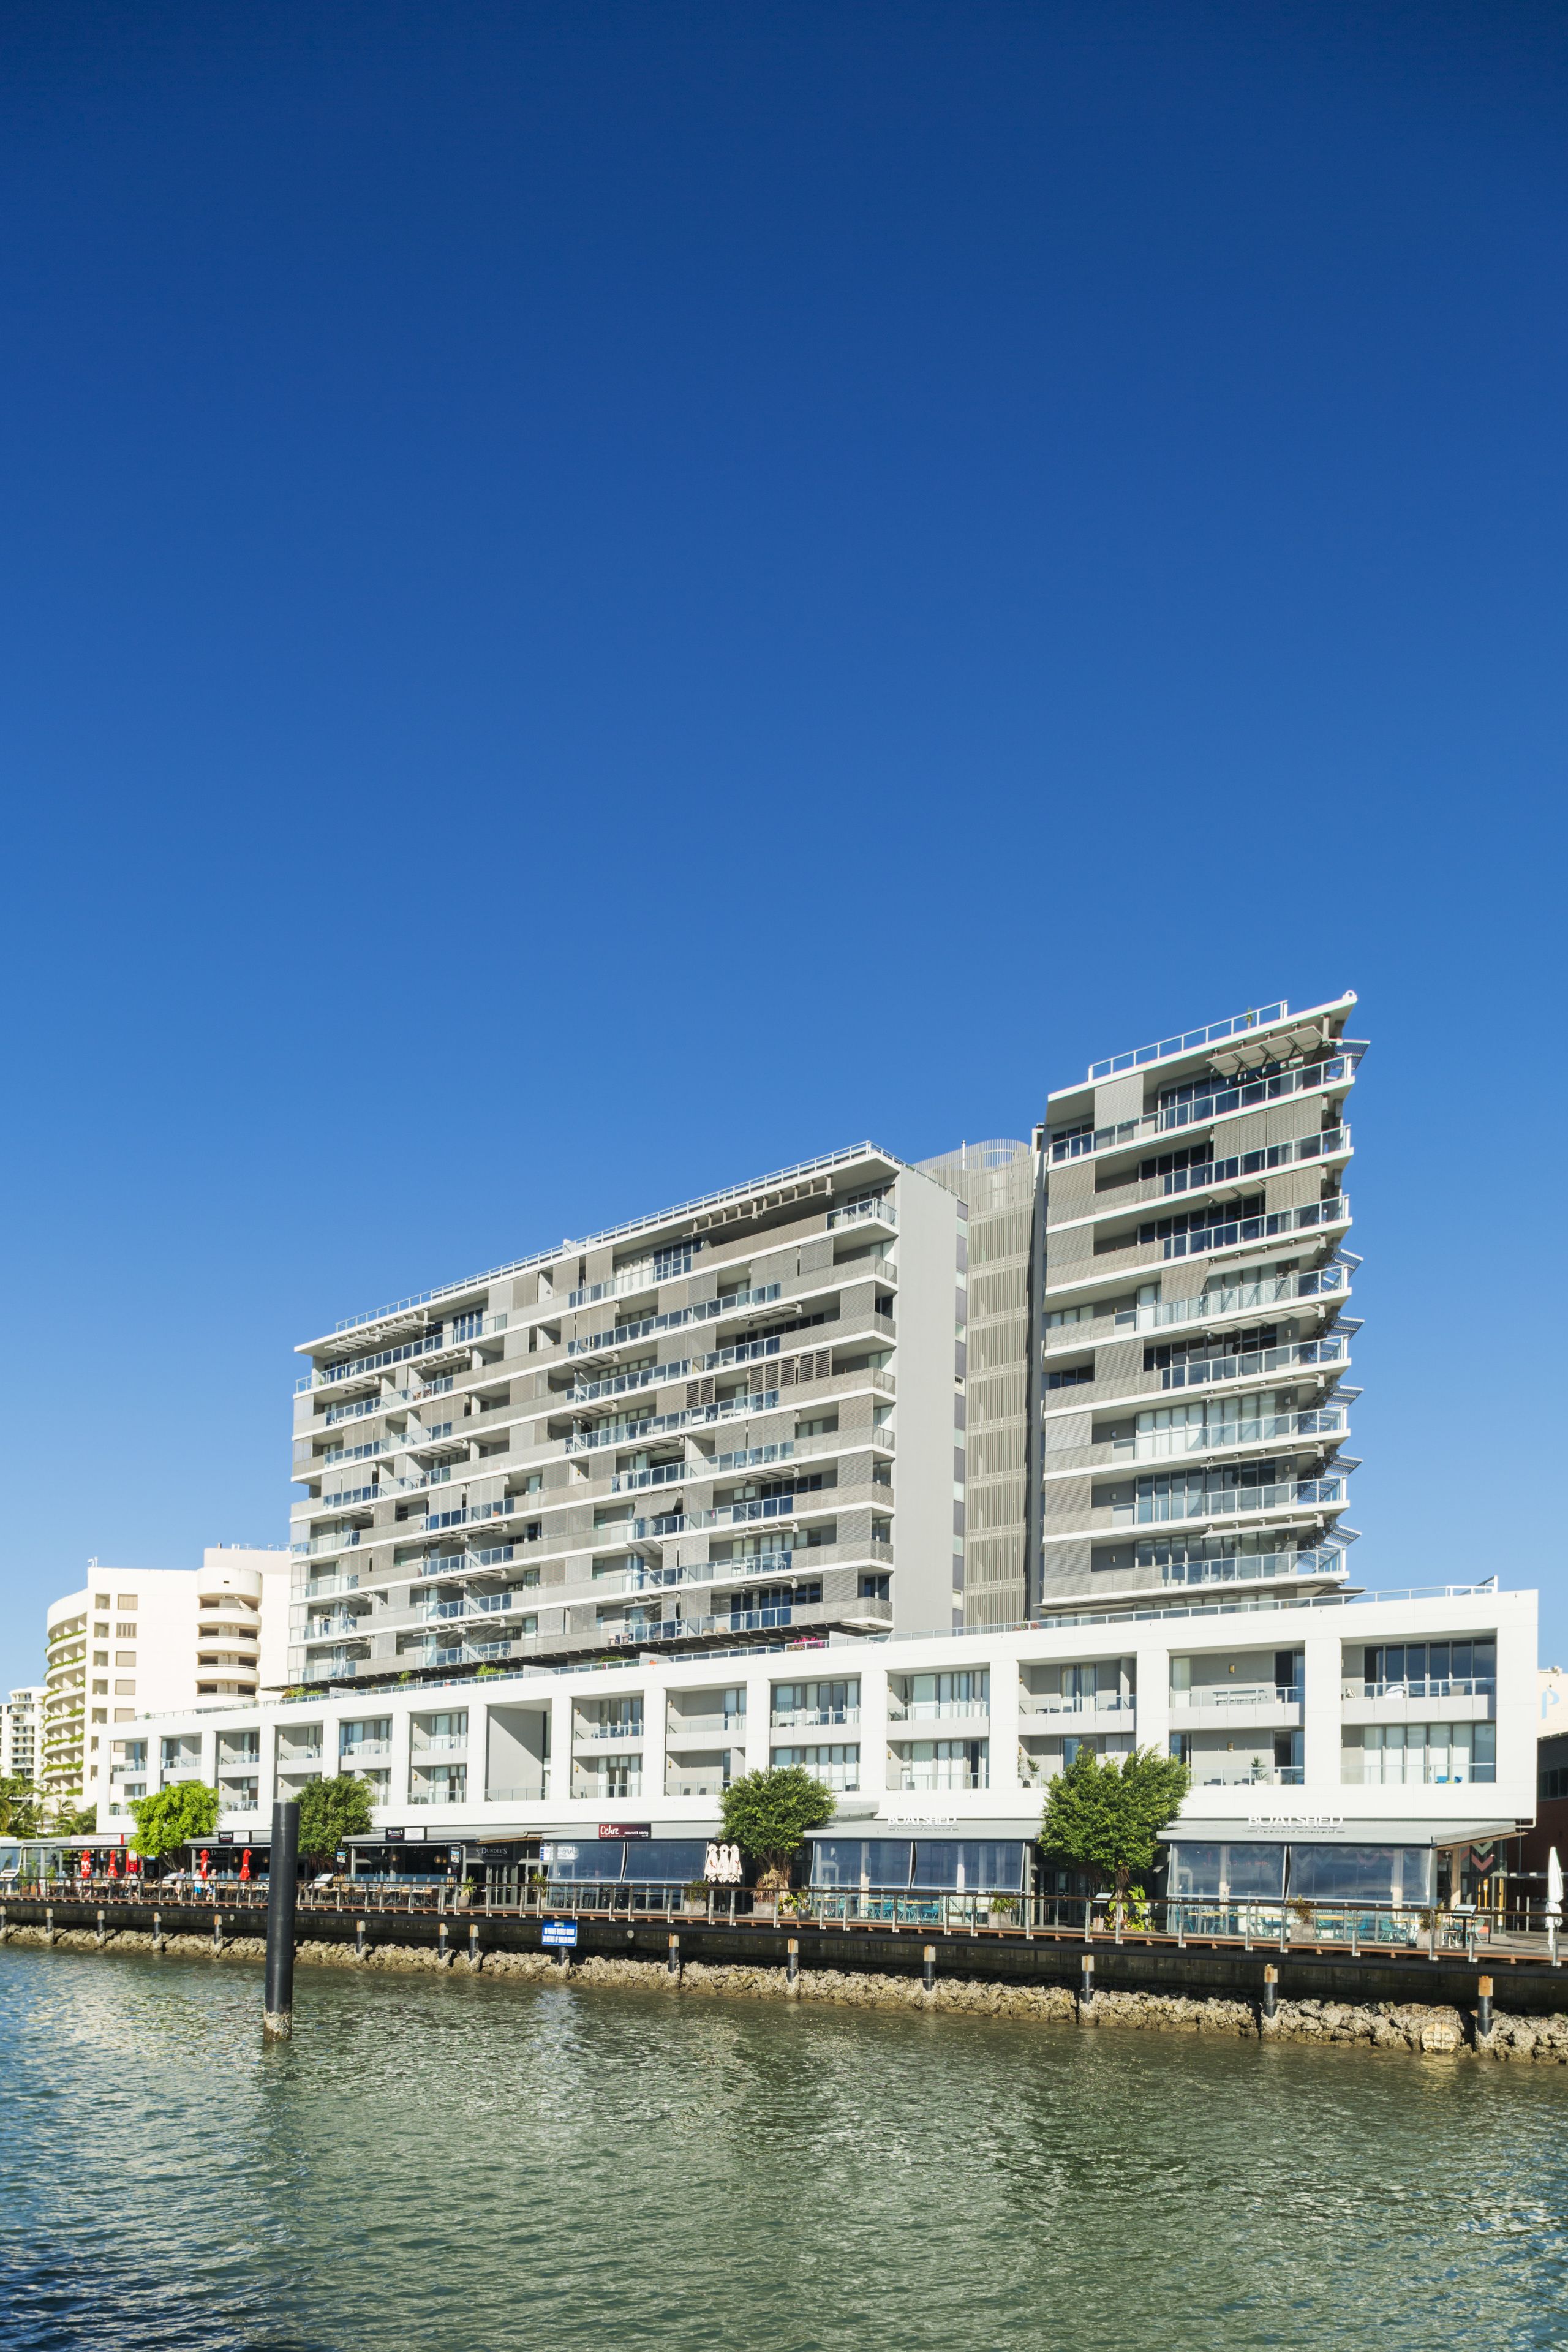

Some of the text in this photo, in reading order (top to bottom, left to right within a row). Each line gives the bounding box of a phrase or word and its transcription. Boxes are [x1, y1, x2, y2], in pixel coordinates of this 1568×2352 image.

[888, 1814, 957, 1826] BOATSHED
[1248, 1813, 1343, 1827] BOATSHED
[600, 1825, 620, 1835] Ochre
